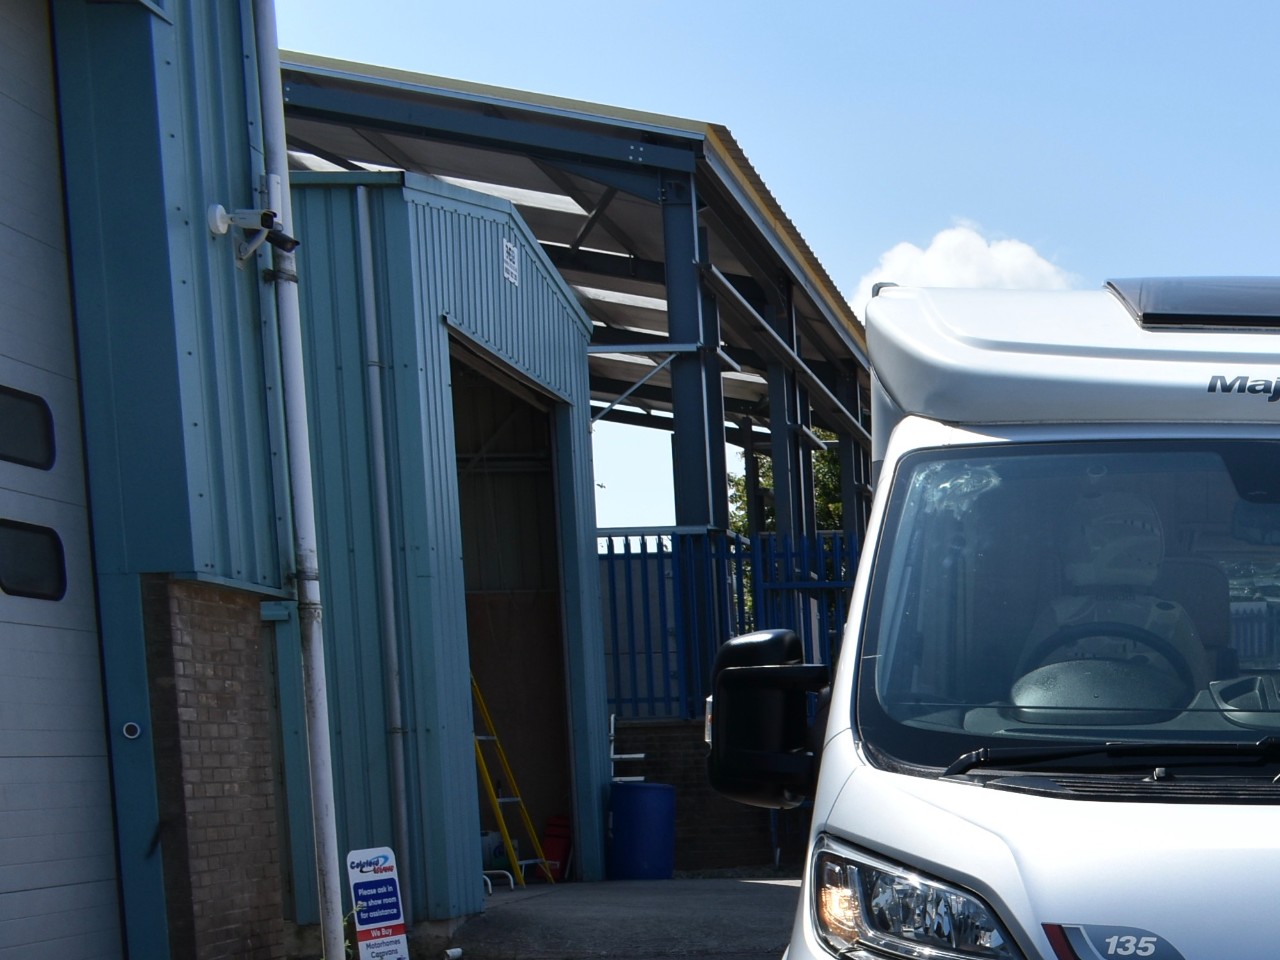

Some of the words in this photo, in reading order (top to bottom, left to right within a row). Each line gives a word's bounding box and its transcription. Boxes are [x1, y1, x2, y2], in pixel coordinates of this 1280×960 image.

[358, 887, 377, 896] Please
[377, 885, 387, 894] ask
[387, 884, 394, 892] in
[368, 898, 382, 906] show
[369, 908, 397, 918] assistance
[370, 928, 380, 937] We
[381, 927, 392, 936] Buy
[365, 939, 401, 950] Motorhomes
[1105, 935, 1157, 957] 135
[370, 948, 399, 958] Caravans
